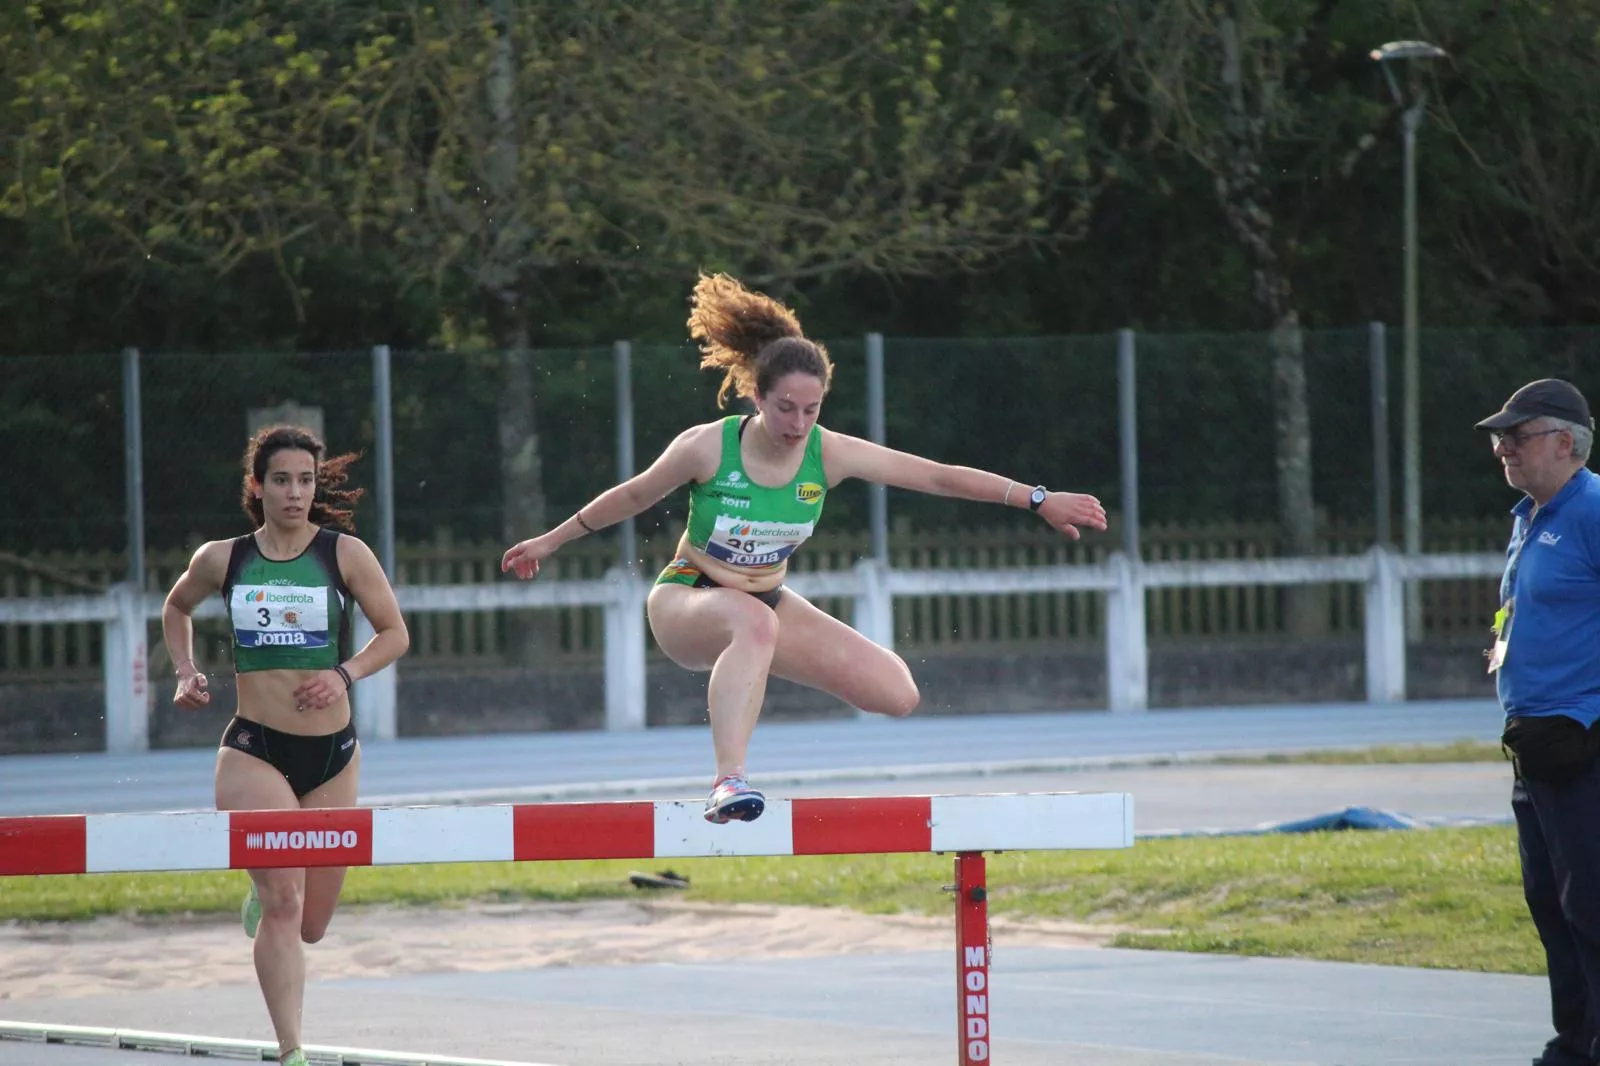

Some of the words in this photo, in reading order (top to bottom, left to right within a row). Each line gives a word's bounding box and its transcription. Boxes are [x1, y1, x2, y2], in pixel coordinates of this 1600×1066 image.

[751, 527, 800, 537] Iberdrola
[266, 591, 314, 603] Iberdrola
[257, 607, 271, 628] 3
[254, 631, 307, 646] Joma
[265, 830, 358, 849] MONDO
[965, 946, 988, 1061] MONDO
